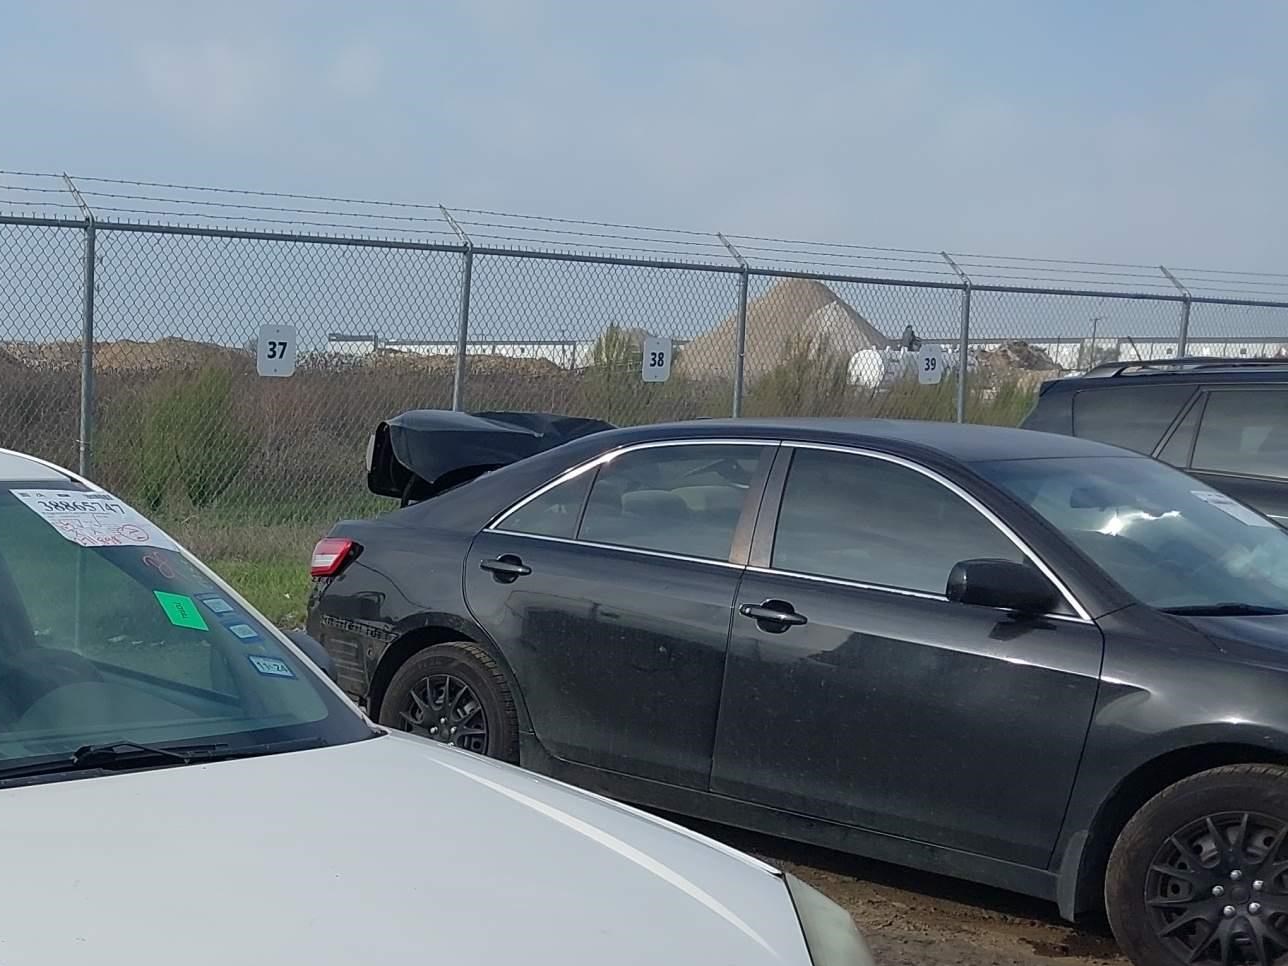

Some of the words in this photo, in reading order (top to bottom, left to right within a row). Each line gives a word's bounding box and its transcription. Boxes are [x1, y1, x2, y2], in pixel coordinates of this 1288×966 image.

[266, 340, 288, 360] 37
[649, 351, 665, 368] 38
[923, 357, 937, 372] 39
[38, 501, 125, 514] 38865747
